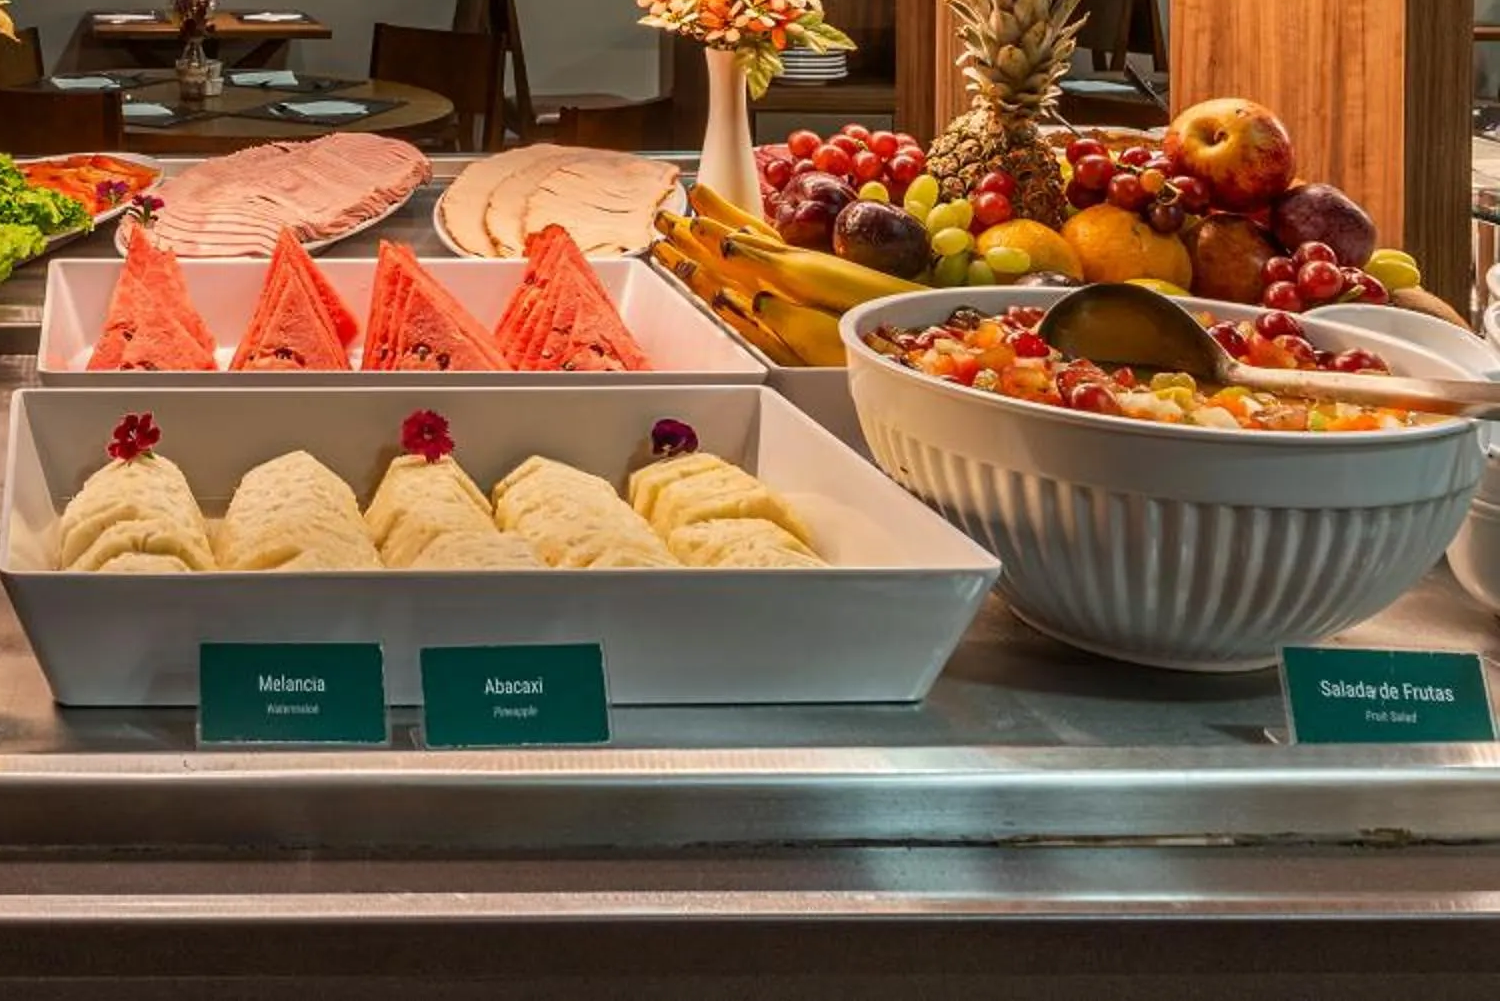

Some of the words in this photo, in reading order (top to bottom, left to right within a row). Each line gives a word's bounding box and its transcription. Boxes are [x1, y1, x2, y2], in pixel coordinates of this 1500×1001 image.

[259, 674, 325, 692] Melancia
[484, 676, 543, 695] Abacaxi
[1320, 679, 1377, 700] Salada
[1379, 682, 1400, 701] de
[1403, 682, 1455, 703] Frutas
